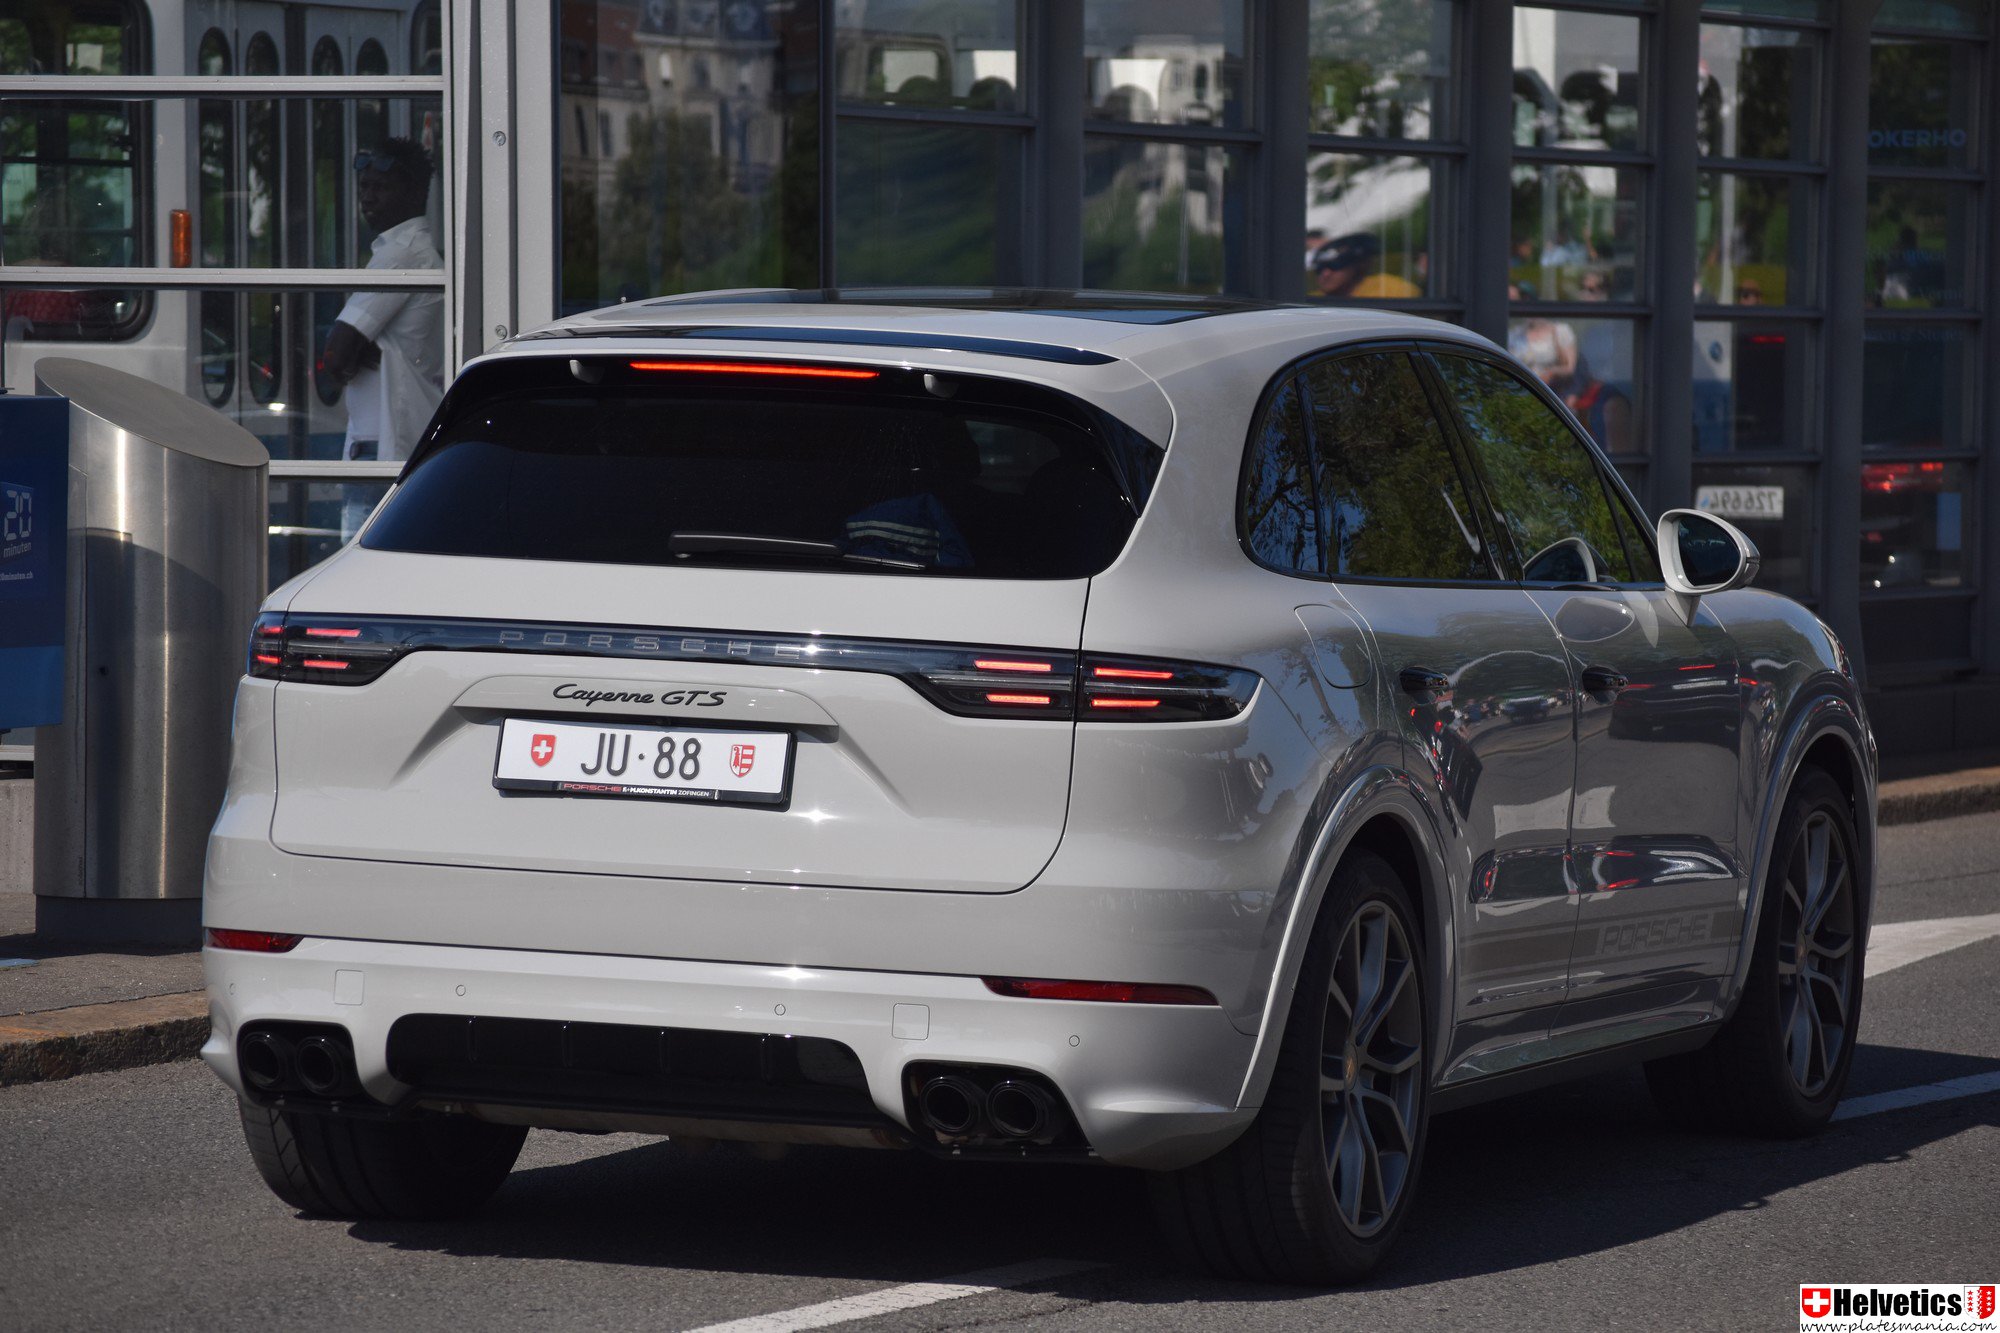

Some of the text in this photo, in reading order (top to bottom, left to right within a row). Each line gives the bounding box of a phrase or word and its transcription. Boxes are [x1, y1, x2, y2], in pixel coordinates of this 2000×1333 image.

[4, 490, 32, 541] 20
[3, 542, 32, 558] minuten
[500, 631, 800, 660] PORSCHE
[553, 684, 727, 706] Cayenne GTS
[563, 783, 622, 793] PORSCHE
[678, 789, 710, 797] ZOFINGEN
[1601, 913, 1709, 954] PORSCHE
